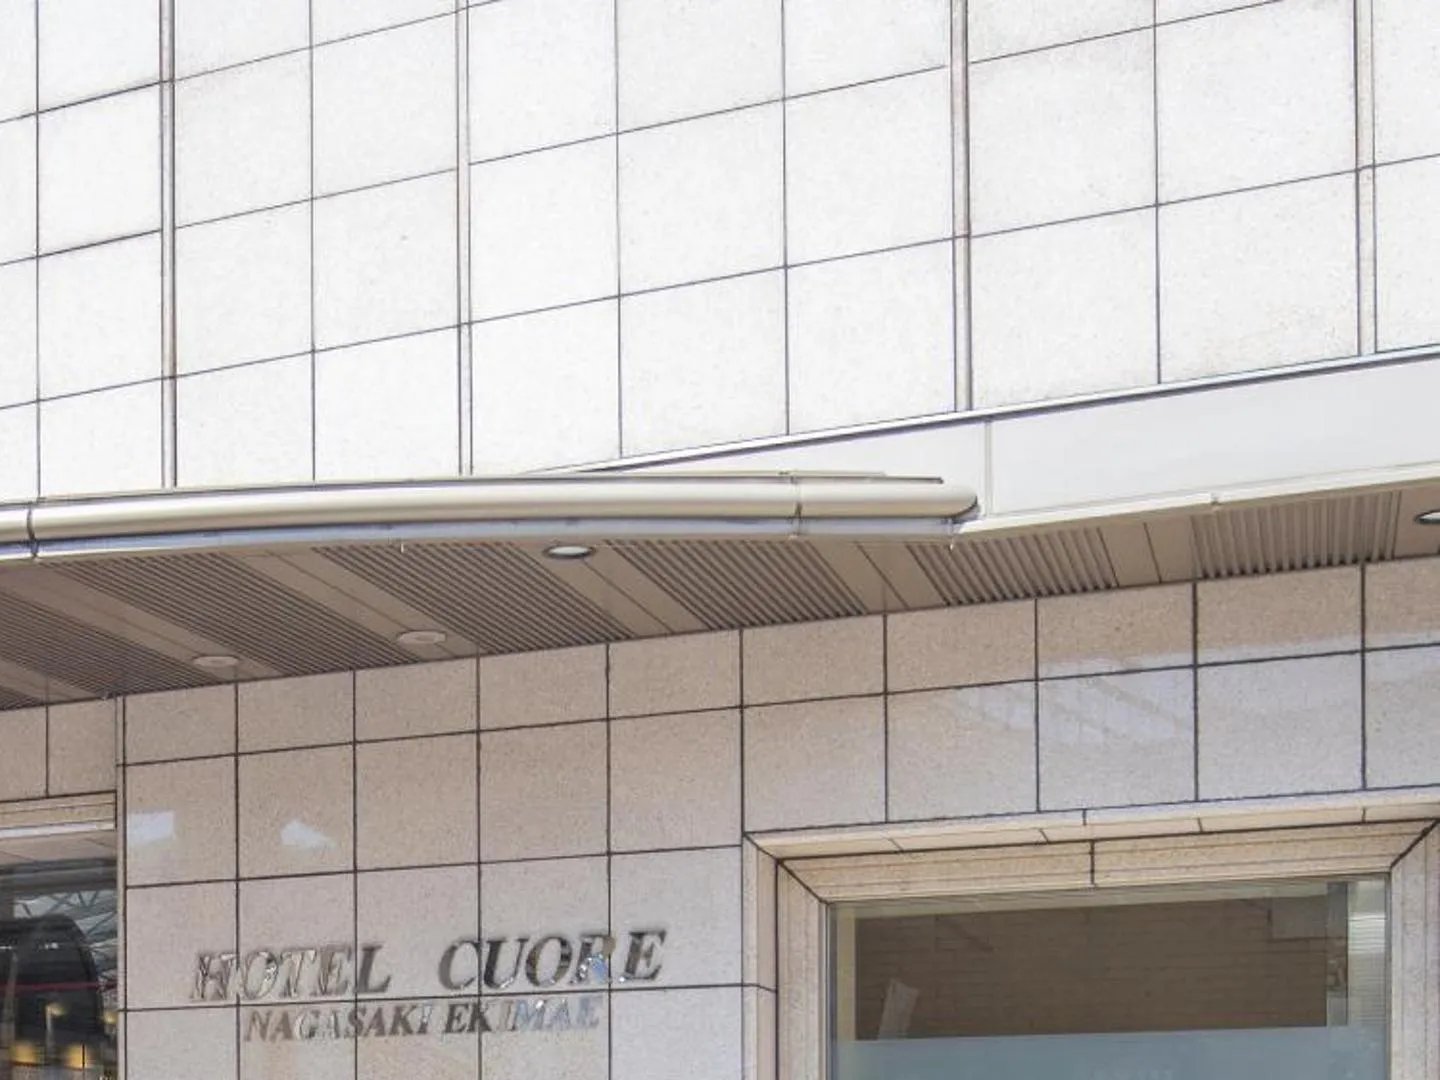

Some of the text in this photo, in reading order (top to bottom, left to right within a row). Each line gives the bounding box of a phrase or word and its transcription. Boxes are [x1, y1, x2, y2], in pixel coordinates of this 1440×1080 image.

[189, 929, 667, 1000] HOTEL CUORE
[243, 997, 604, 1042] NAGASAKI EKIMAE
